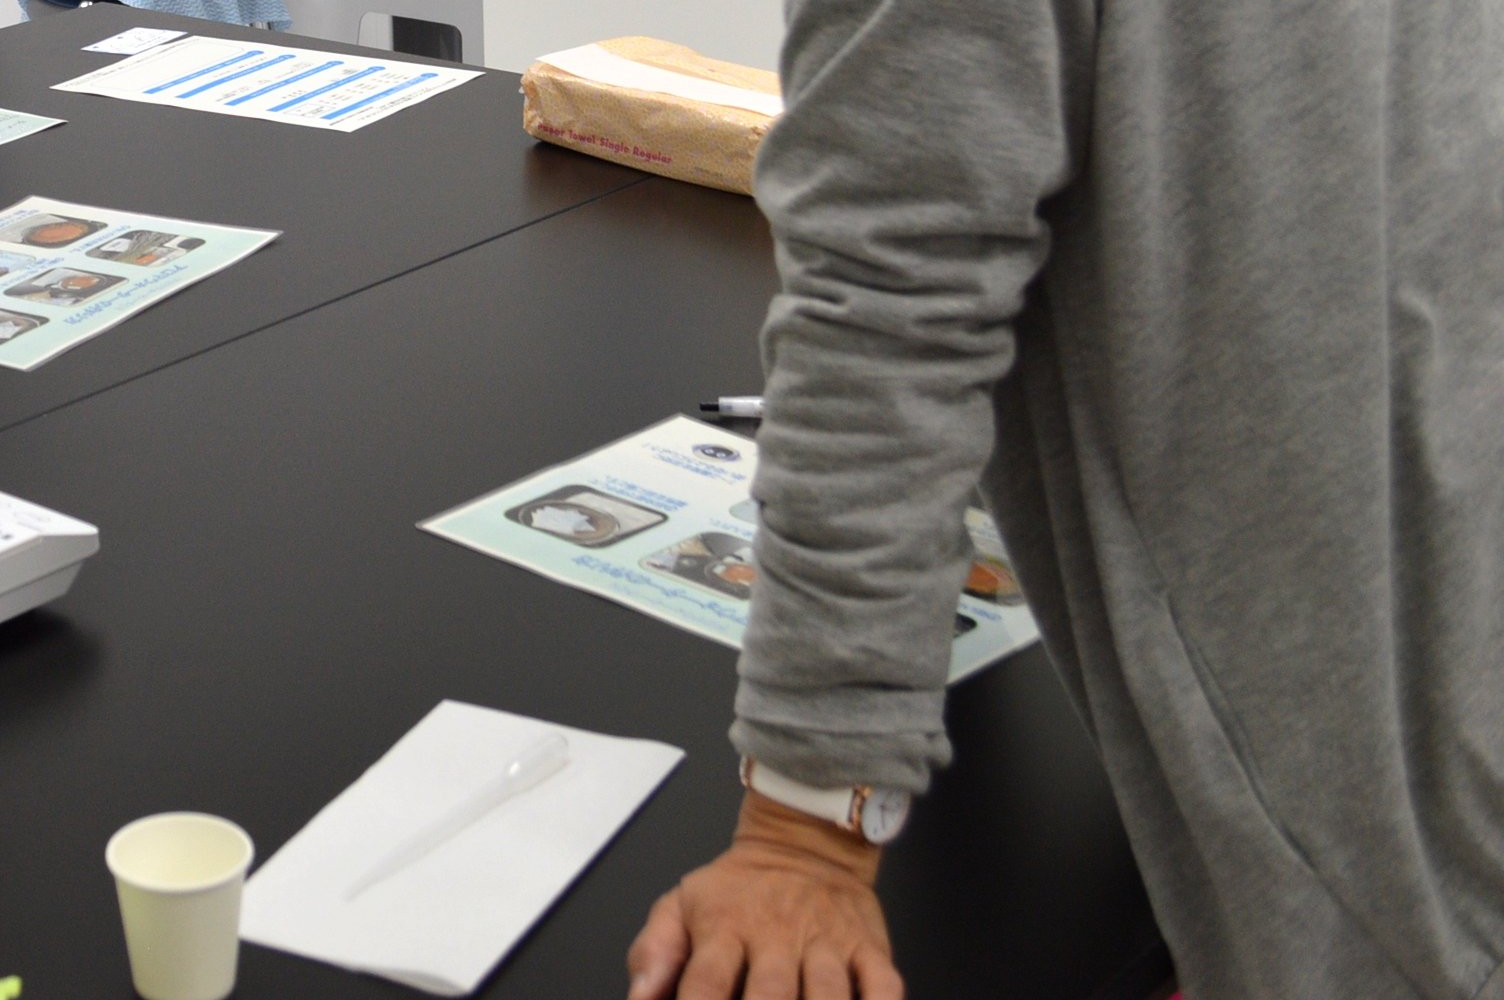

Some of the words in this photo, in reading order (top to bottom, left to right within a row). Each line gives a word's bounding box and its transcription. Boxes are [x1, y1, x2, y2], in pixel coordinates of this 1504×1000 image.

[569, 129, 596, 145] Towel
[599, 137, 630, 154] Single
[633, 146, 673, 165] Regular
